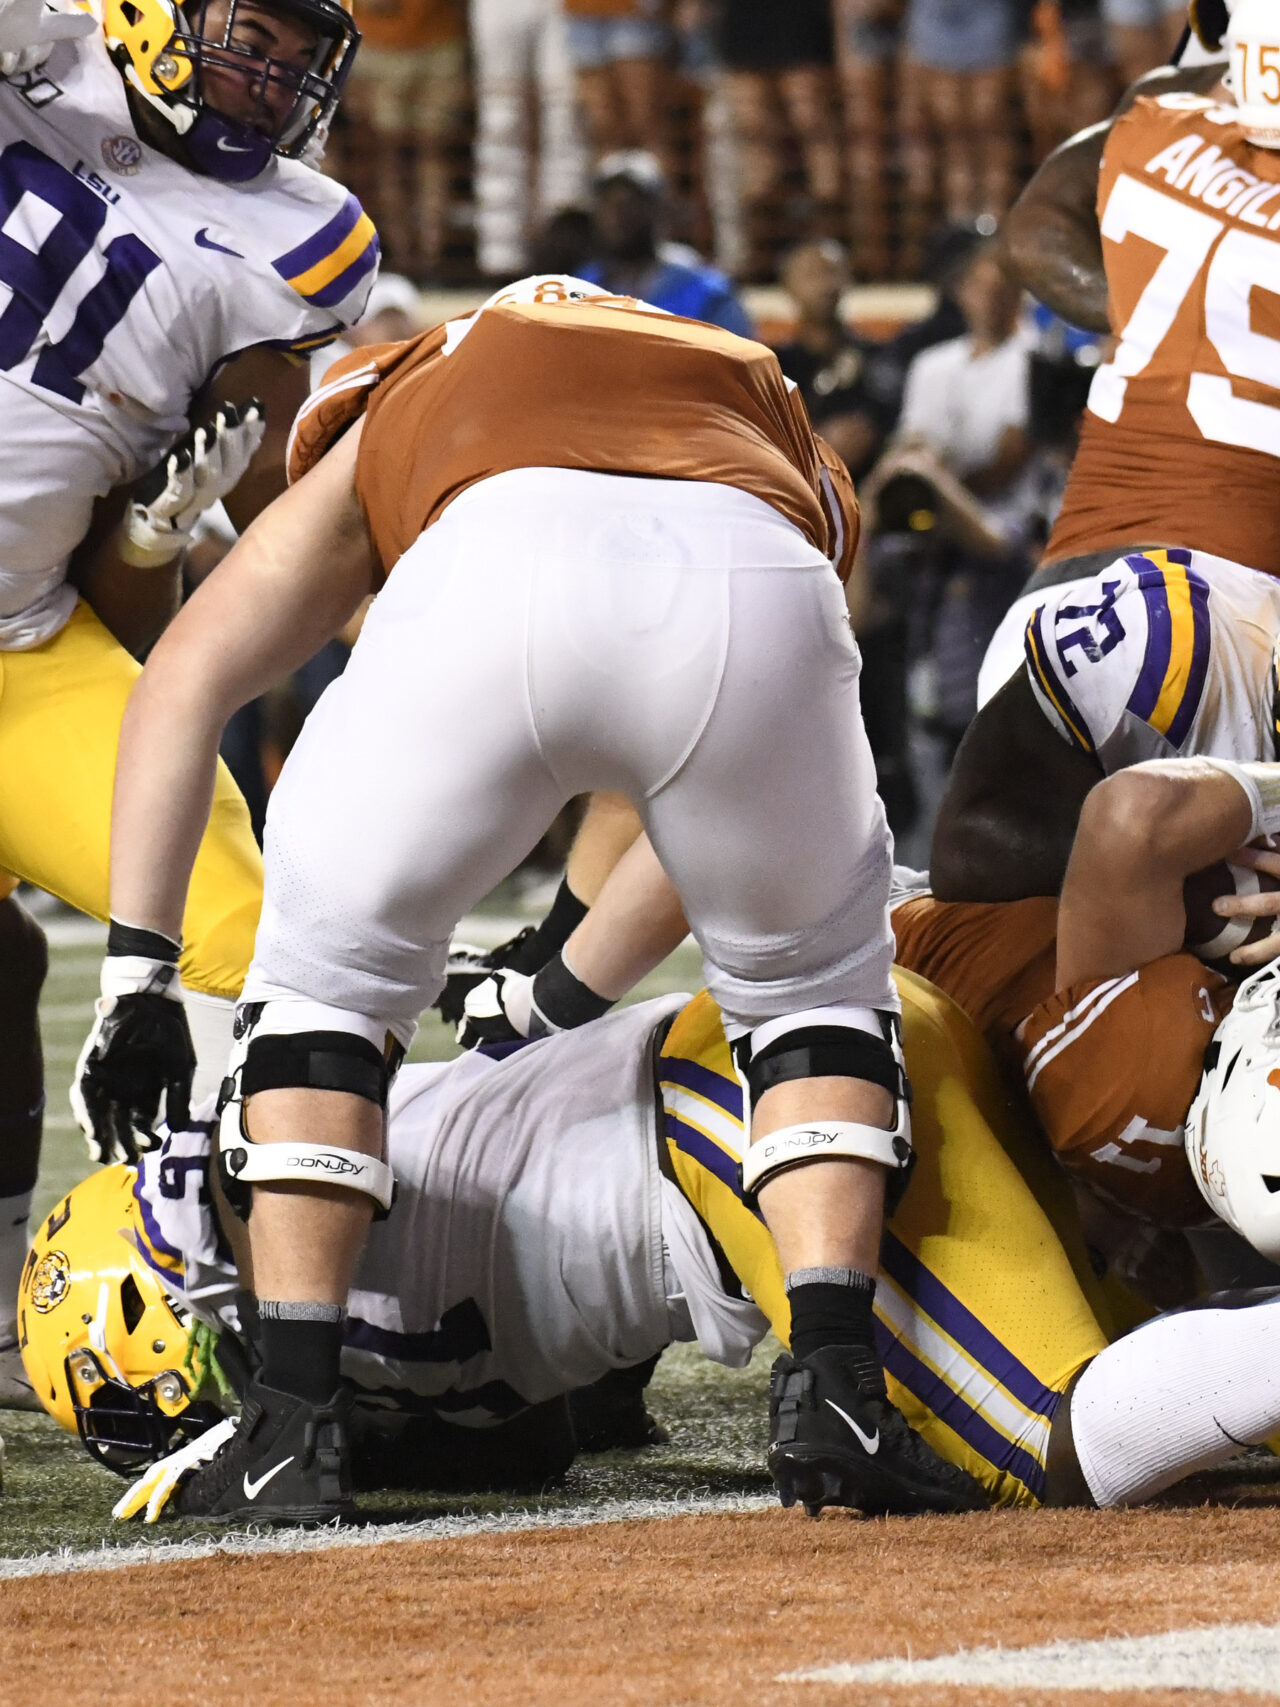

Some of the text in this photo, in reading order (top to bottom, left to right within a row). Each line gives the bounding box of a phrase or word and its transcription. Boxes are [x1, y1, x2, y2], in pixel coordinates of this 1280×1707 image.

[72, 160, 121, 205] LSU
[0, 139, 163, 406] 91
[1090, 1114, 1185, 1175] 11
